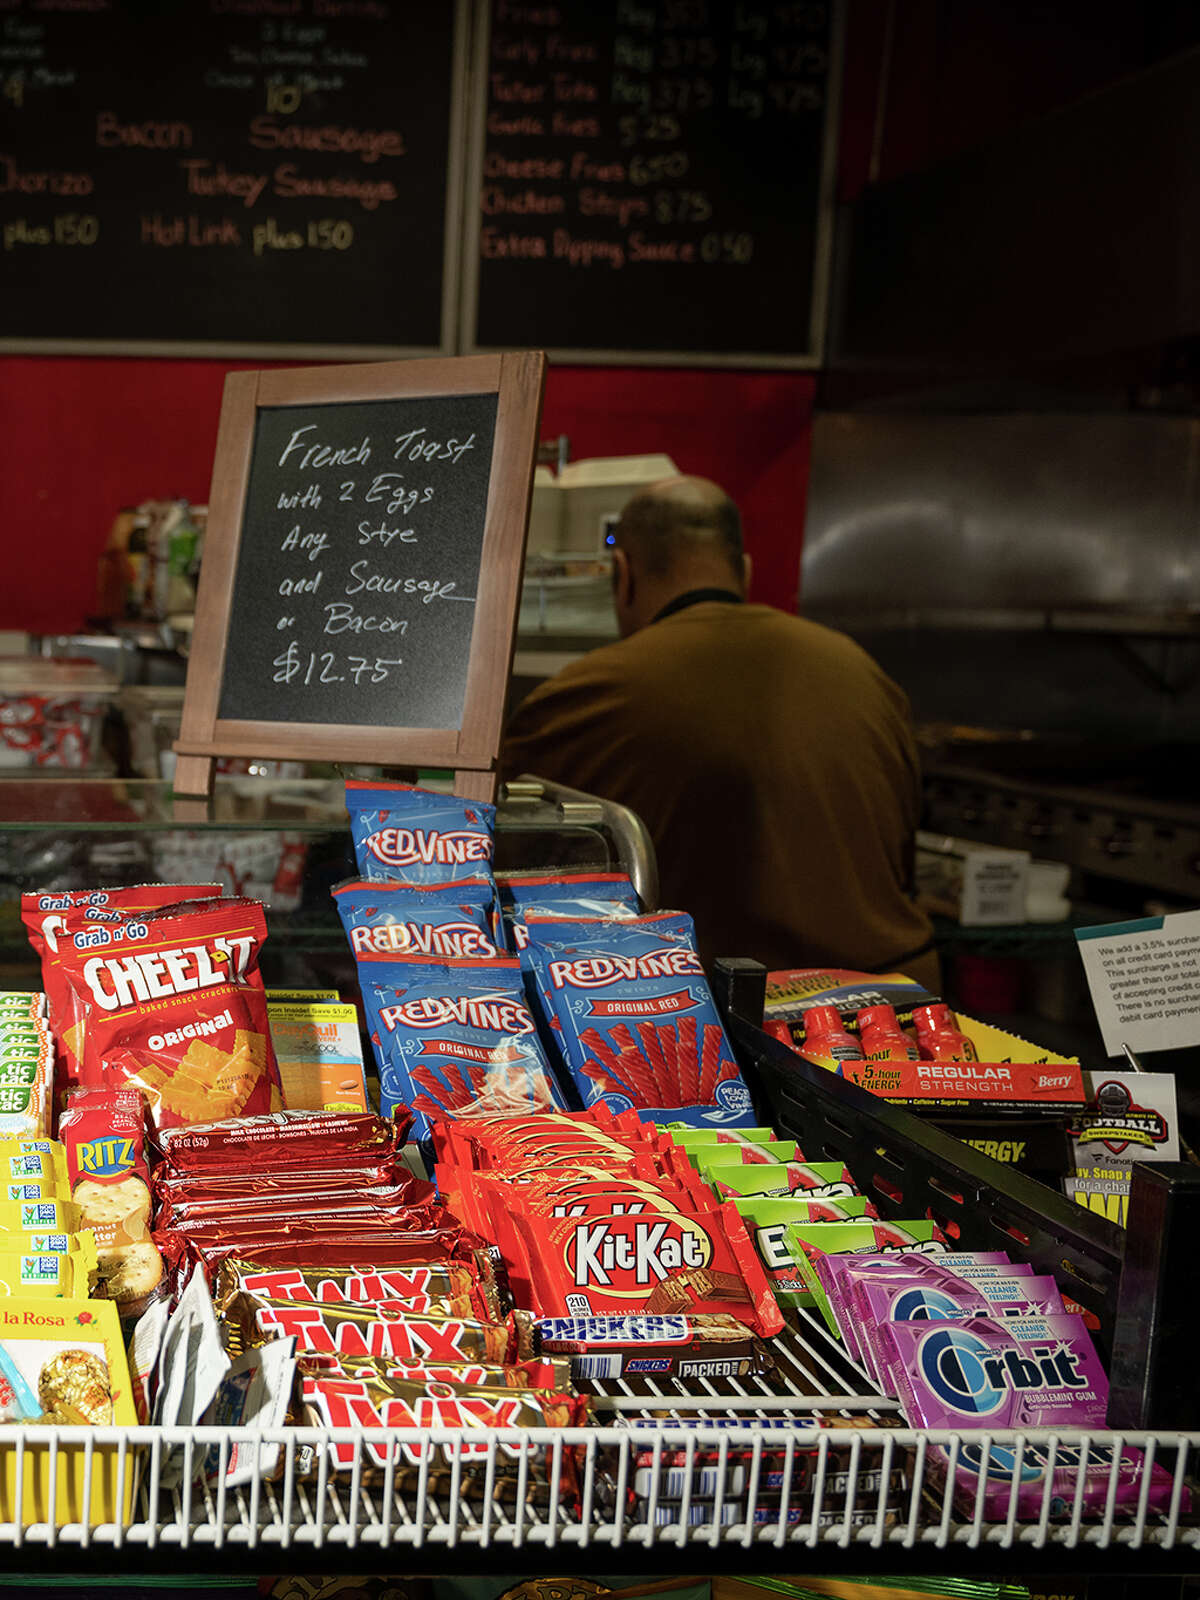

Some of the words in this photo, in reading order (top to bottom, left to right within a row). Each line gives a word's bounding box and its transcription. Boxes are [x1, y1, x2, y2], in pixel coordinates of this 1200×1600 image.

[95, 112, 193, 149] Bacon
[250, 115, 406, 163] Sausage
[483, 152, 564, 179] Cheese
[180, 159, 268, 208] Turkey
[273, 163, 398, 210] Sausage
[482, 184, 565, 215] Chicken
[3, 218, 50, 251] plus
[252, 219, 304, 256] plus
[482, 227, 546, 259] Extra
[278, 425, 371, 470] French
[395, 428, 475, 463] Toast
[278, 486, 321, 510] with
[340, 482, 354, 502] 2
[365, 474, 434, 513] Eggs
[281, 526, 330, 560] Any
[278, 572, 322, 597] and
[345, 561, 476, 604] Sausage
[324, 603, 408, 635] Bacon
[273, 642, 402, 685] $12.75
[74, 927, 112, 950] Grab
[127, 922, 148, 939] Go
[1116, 944, 1133, 954] add
[1106, 969, 1125, 978] This
[1127, 964, 1170, 975] surcharge
[1182, 959, 1197, 967] not
[1128, 953, 1153, 964] credit
[1154, 951, 1173, 960] card
[1109, 979, 1141, 991] greater
[1143, 976, 1163, 985] than
[1164, 973, 1179, 982] our
[1124, 986, 1167, 1000] accepting
[1168, 982, 1193, 993] credit
[140, 1001, 169, 1015] baked
[171, 993, 197, 1008] snack
[201, 985, 240, 1001] crackers
[606, 1001, 656, 1015] ORIGINAL
[658, 997, 681, 1011] RED
[1116, 1002, 1142, 1012] There
[1119, 1014, 1142, 1024] debit
[1143, 1010, 1164, 1020] card
[273, 1023, 339, 1040] DayQuil
[860, 1079, 902, 1090] ENERGY
[919, 1080, 1014, 1092] STRENGTH
[1038, 1073, 1072, 1091] Berry
[864, 1064, 901, 1079] 5-hour
[917, 1066, 1011, 1080] REGULAR
[1072, 1117, 1161, 1134] FOOTBALL
[1087, 1129, 1145, 1139] SWEEPSTAKES
[76, 1138, 136, 1172] RITZ
[1093, 1167, 1123, 1181] Snap
[5, 1312, 19, 1325] la
[23, 1312, 65, 1326] Rosa
[542, 1315, 684, 1341] SNICKERS
[682, 1361, 732, 1377] PACKED
[917, 1326, 1089, 1417] Orbit
[1024, 1391, 1075, 1404] BUBBLEMINT
[1076, 1391, 1097, 1402] GUM
